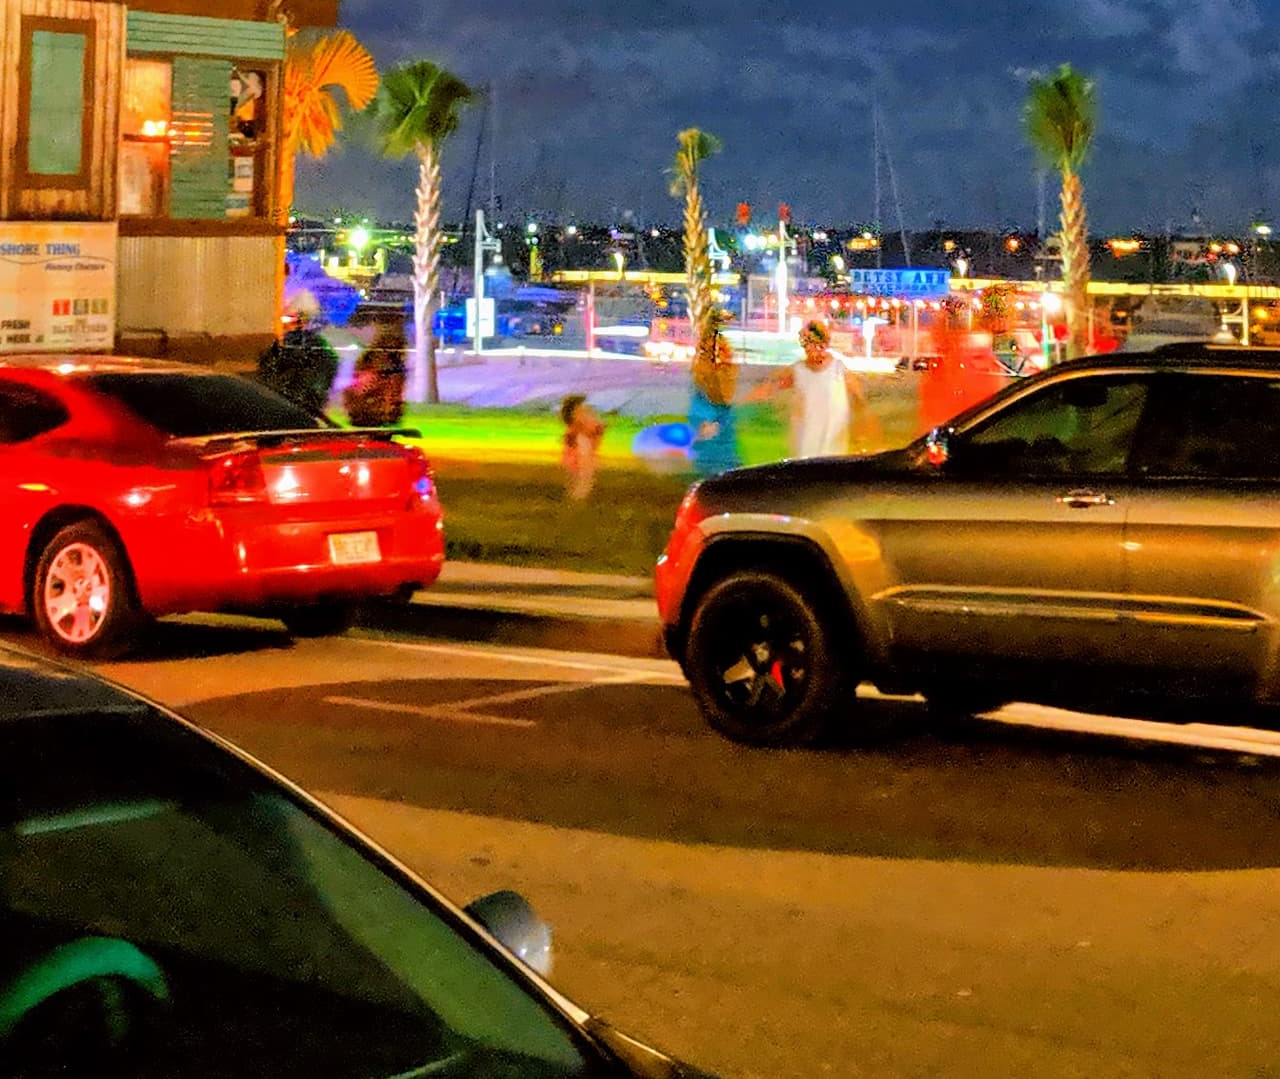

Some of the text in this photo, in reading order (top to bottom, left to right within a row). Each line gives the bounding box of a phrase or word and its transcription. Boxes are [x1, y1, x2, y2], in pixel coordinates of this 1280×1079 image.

[0, 243, 80, 257] SHORE THING
[854, 271, 903, 283] BETSY
[1, 320, 31, 330] FRESH
[6, 334, 31, 344] HERE
